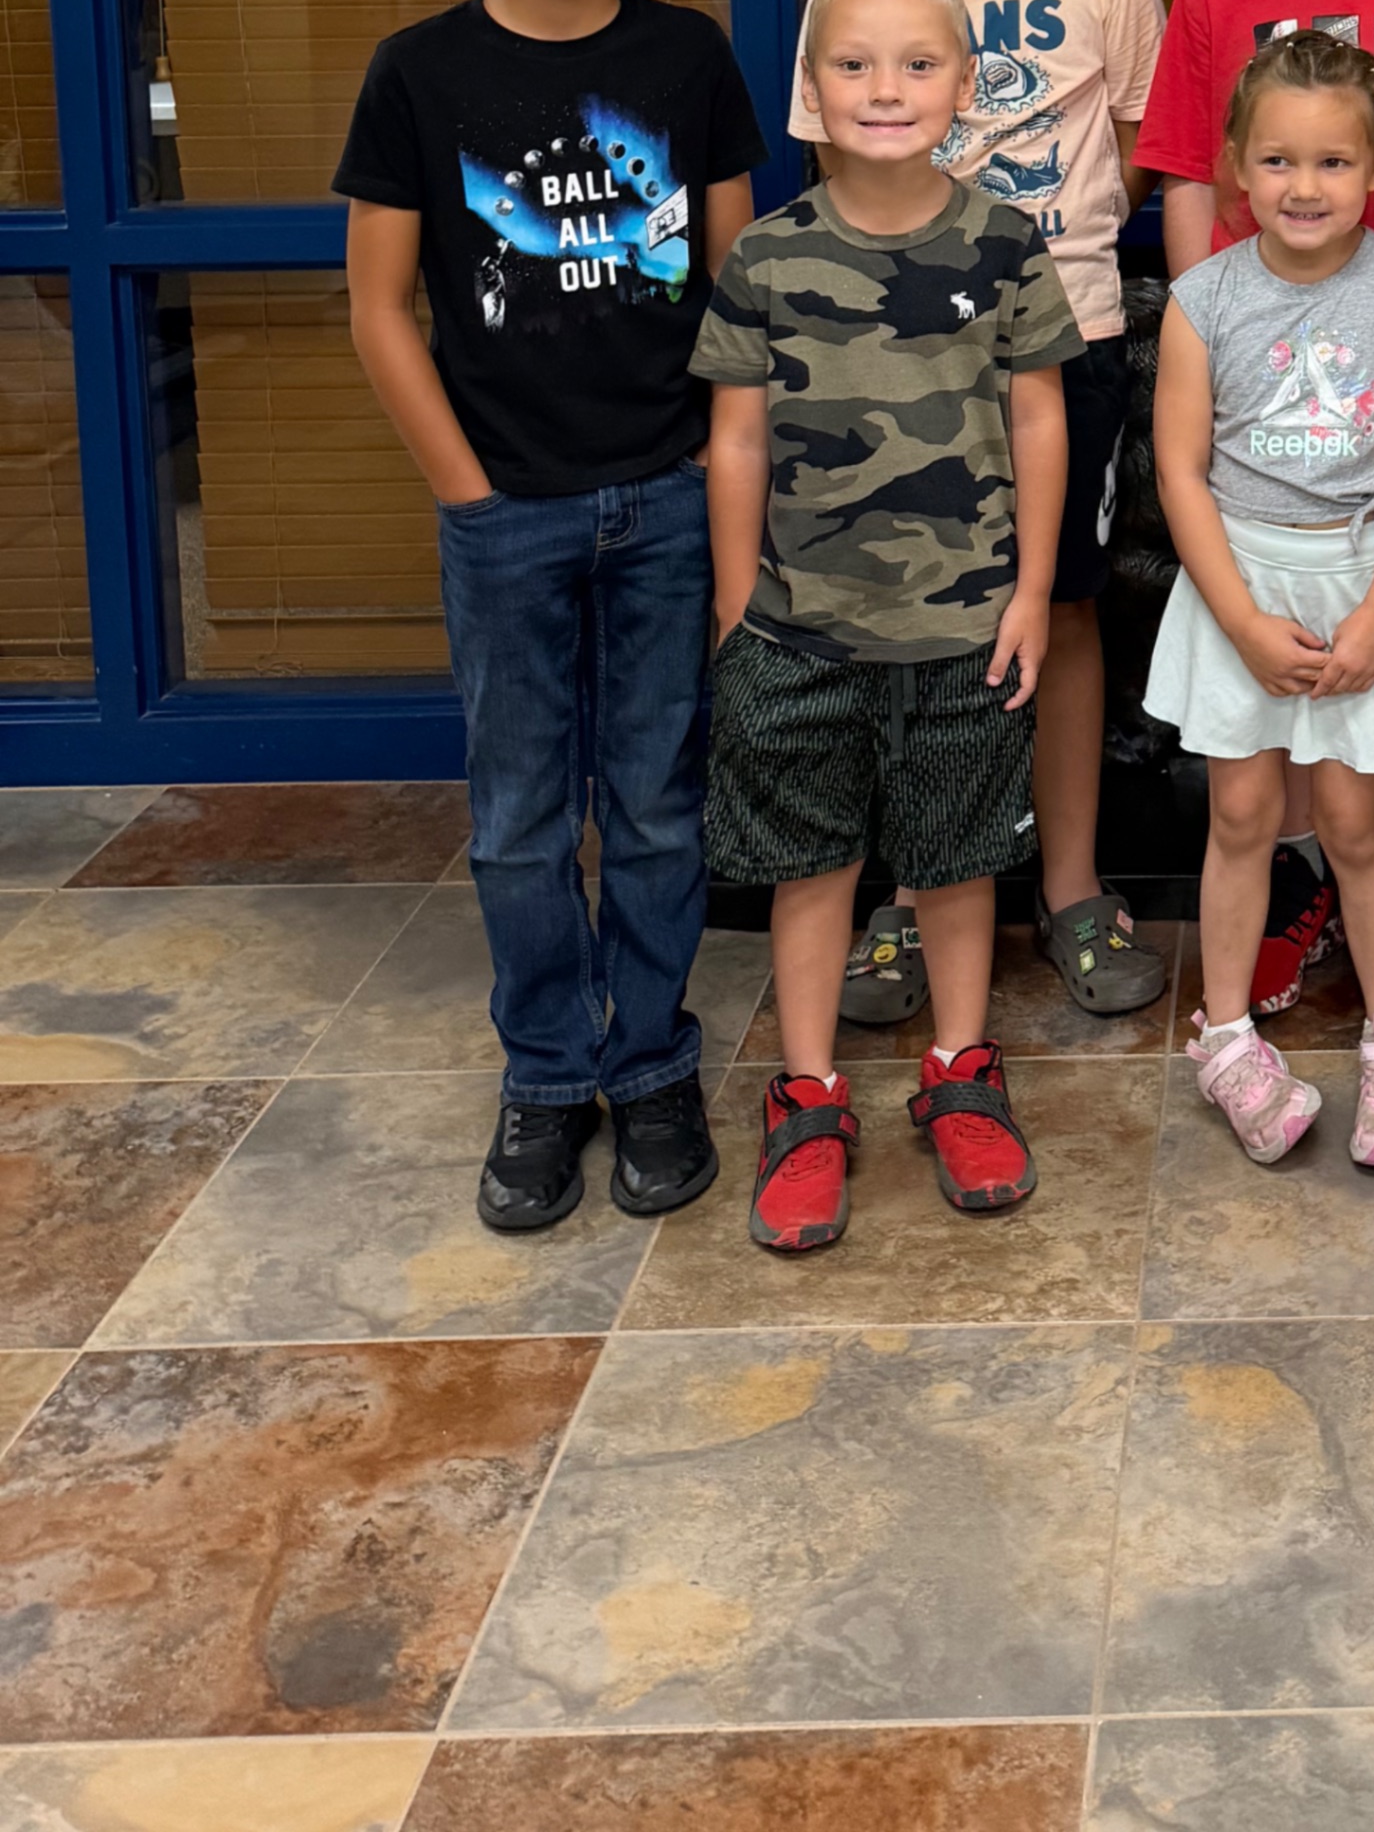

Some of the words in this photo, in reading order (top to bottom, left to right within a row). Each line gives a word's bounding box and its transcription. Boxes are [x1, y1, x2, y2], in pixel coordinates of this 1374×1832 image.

[541, 169, 619, 207] BALL
[559, 213, 614, 248] ALL
[559, 256, 619, 292] OUT
[1250, 430, 1359, 456] Reebok
